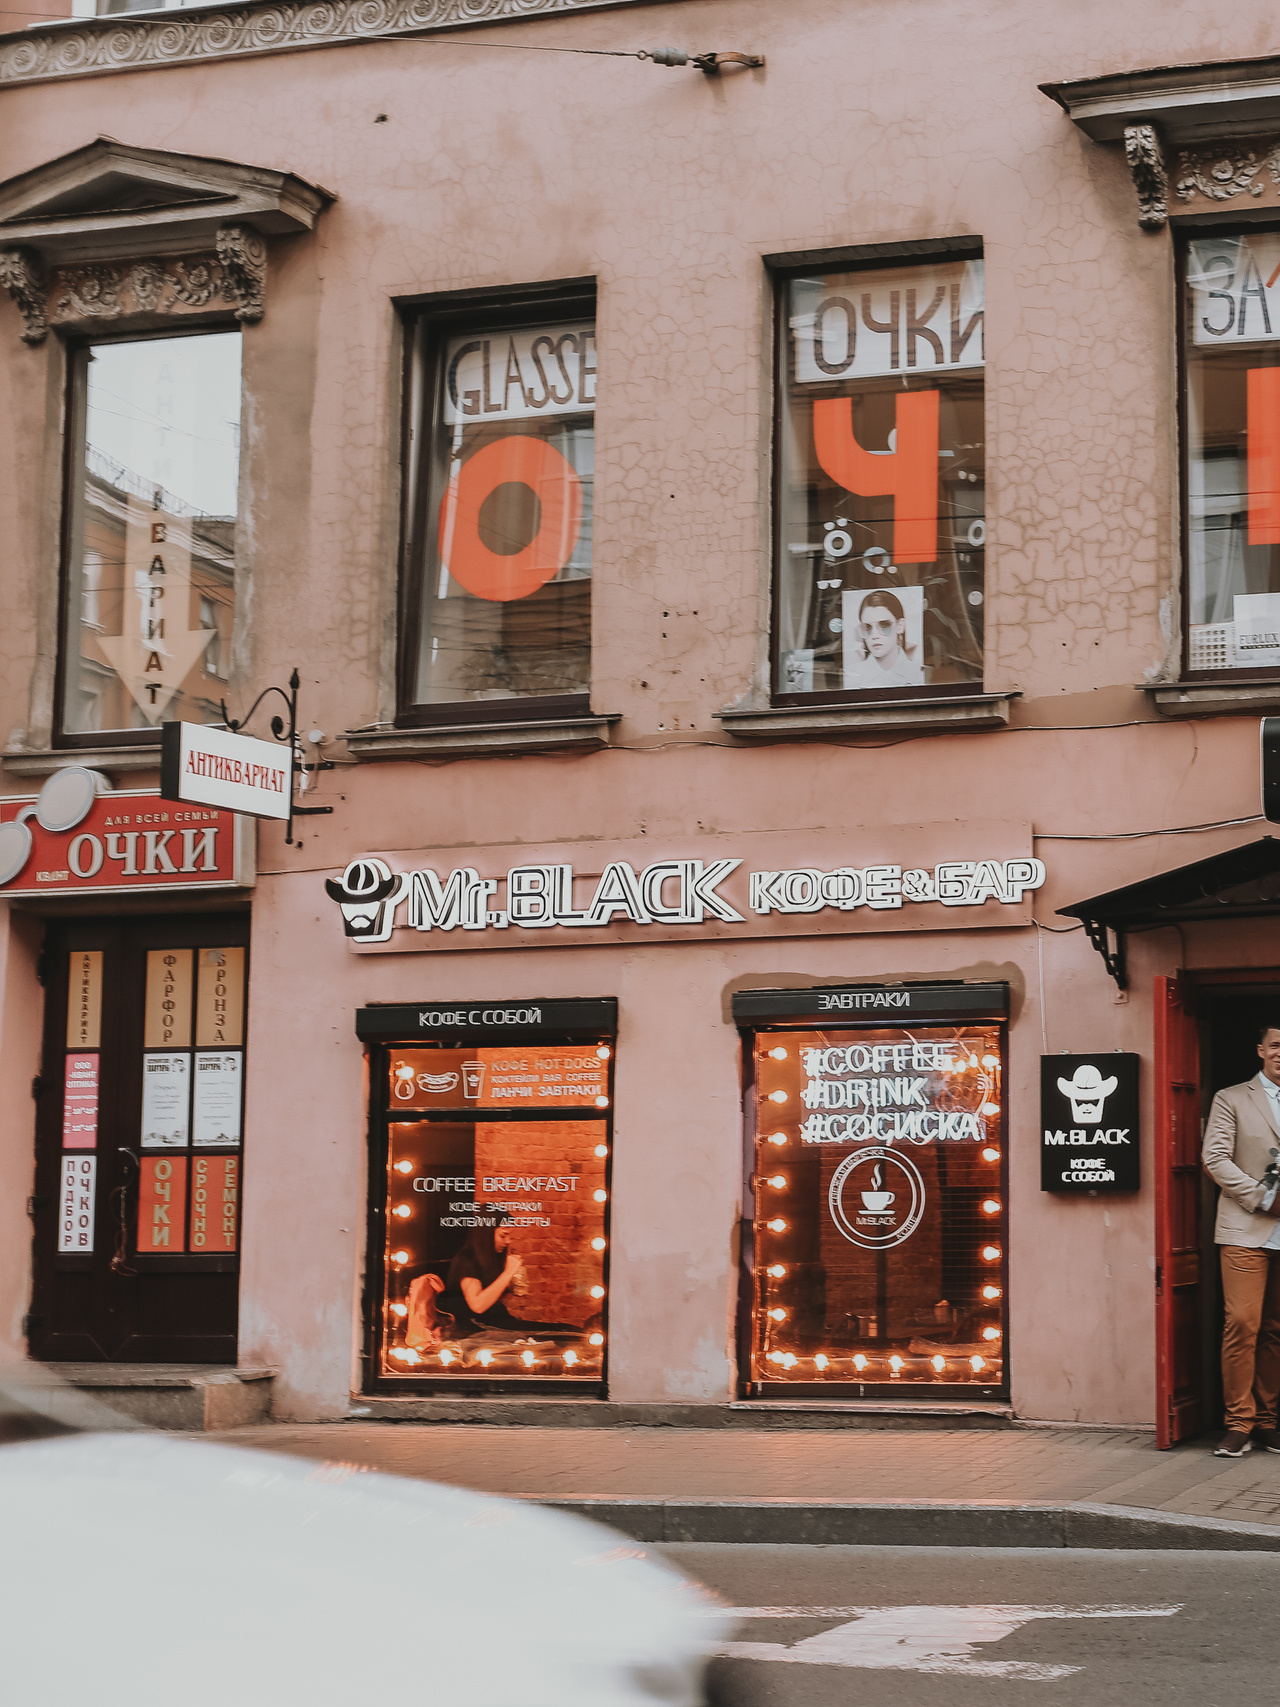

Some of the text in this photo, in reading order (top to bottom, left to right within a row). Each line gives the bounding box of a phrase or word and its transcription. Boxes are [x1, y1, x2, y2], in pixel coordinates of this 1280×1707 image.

[1203, 252, 1272, 337] ЗА
[185, 749, 285, 793] АНТИКВАРИАТ
[104, 810, 219, 827] ДЛЯ ВСЕЙ СЕМЬИ
[67, 827, 219, 878] ОЧКИ
[162, 954, 177, 1043] ФАРФОР
[817, 992, 910, 1010] ЗАВТРАКИ
[418, 1006, 542, 1027] КОФЕ С СОБОЙ
[491, 1056, 602, 1072] КОФЕ HOT DOGS
[542, 1072, 562, 1083] BAR
[565, 1071, 602, 1082] COFFEE
[490, 1084, 602, 1099] ЛАНЧИ ЗАВТРАКИ
[1070, 1158, 1106, 1170] КОФЕ
[413, 1176, 580, 1193] COFFEE BREAKFAST
[1071, 1169, 1115, 1182] СОБОЙ
[64, 1160, 76, 1247] ПОДБОР
[78, 1160, 91, 1247] ОЧКОВ
[152, 1159, 173, 1247] ОЧКИ
[193, 1159, 208, 1247] СРОЧНО
[222, 1159, 237, 1247] РЕМОНТ
[486, 1201, 543, 1212] ЗАВТРАКИ
[499, 1216, 551, 1228] ДЕСЕРТЫ
